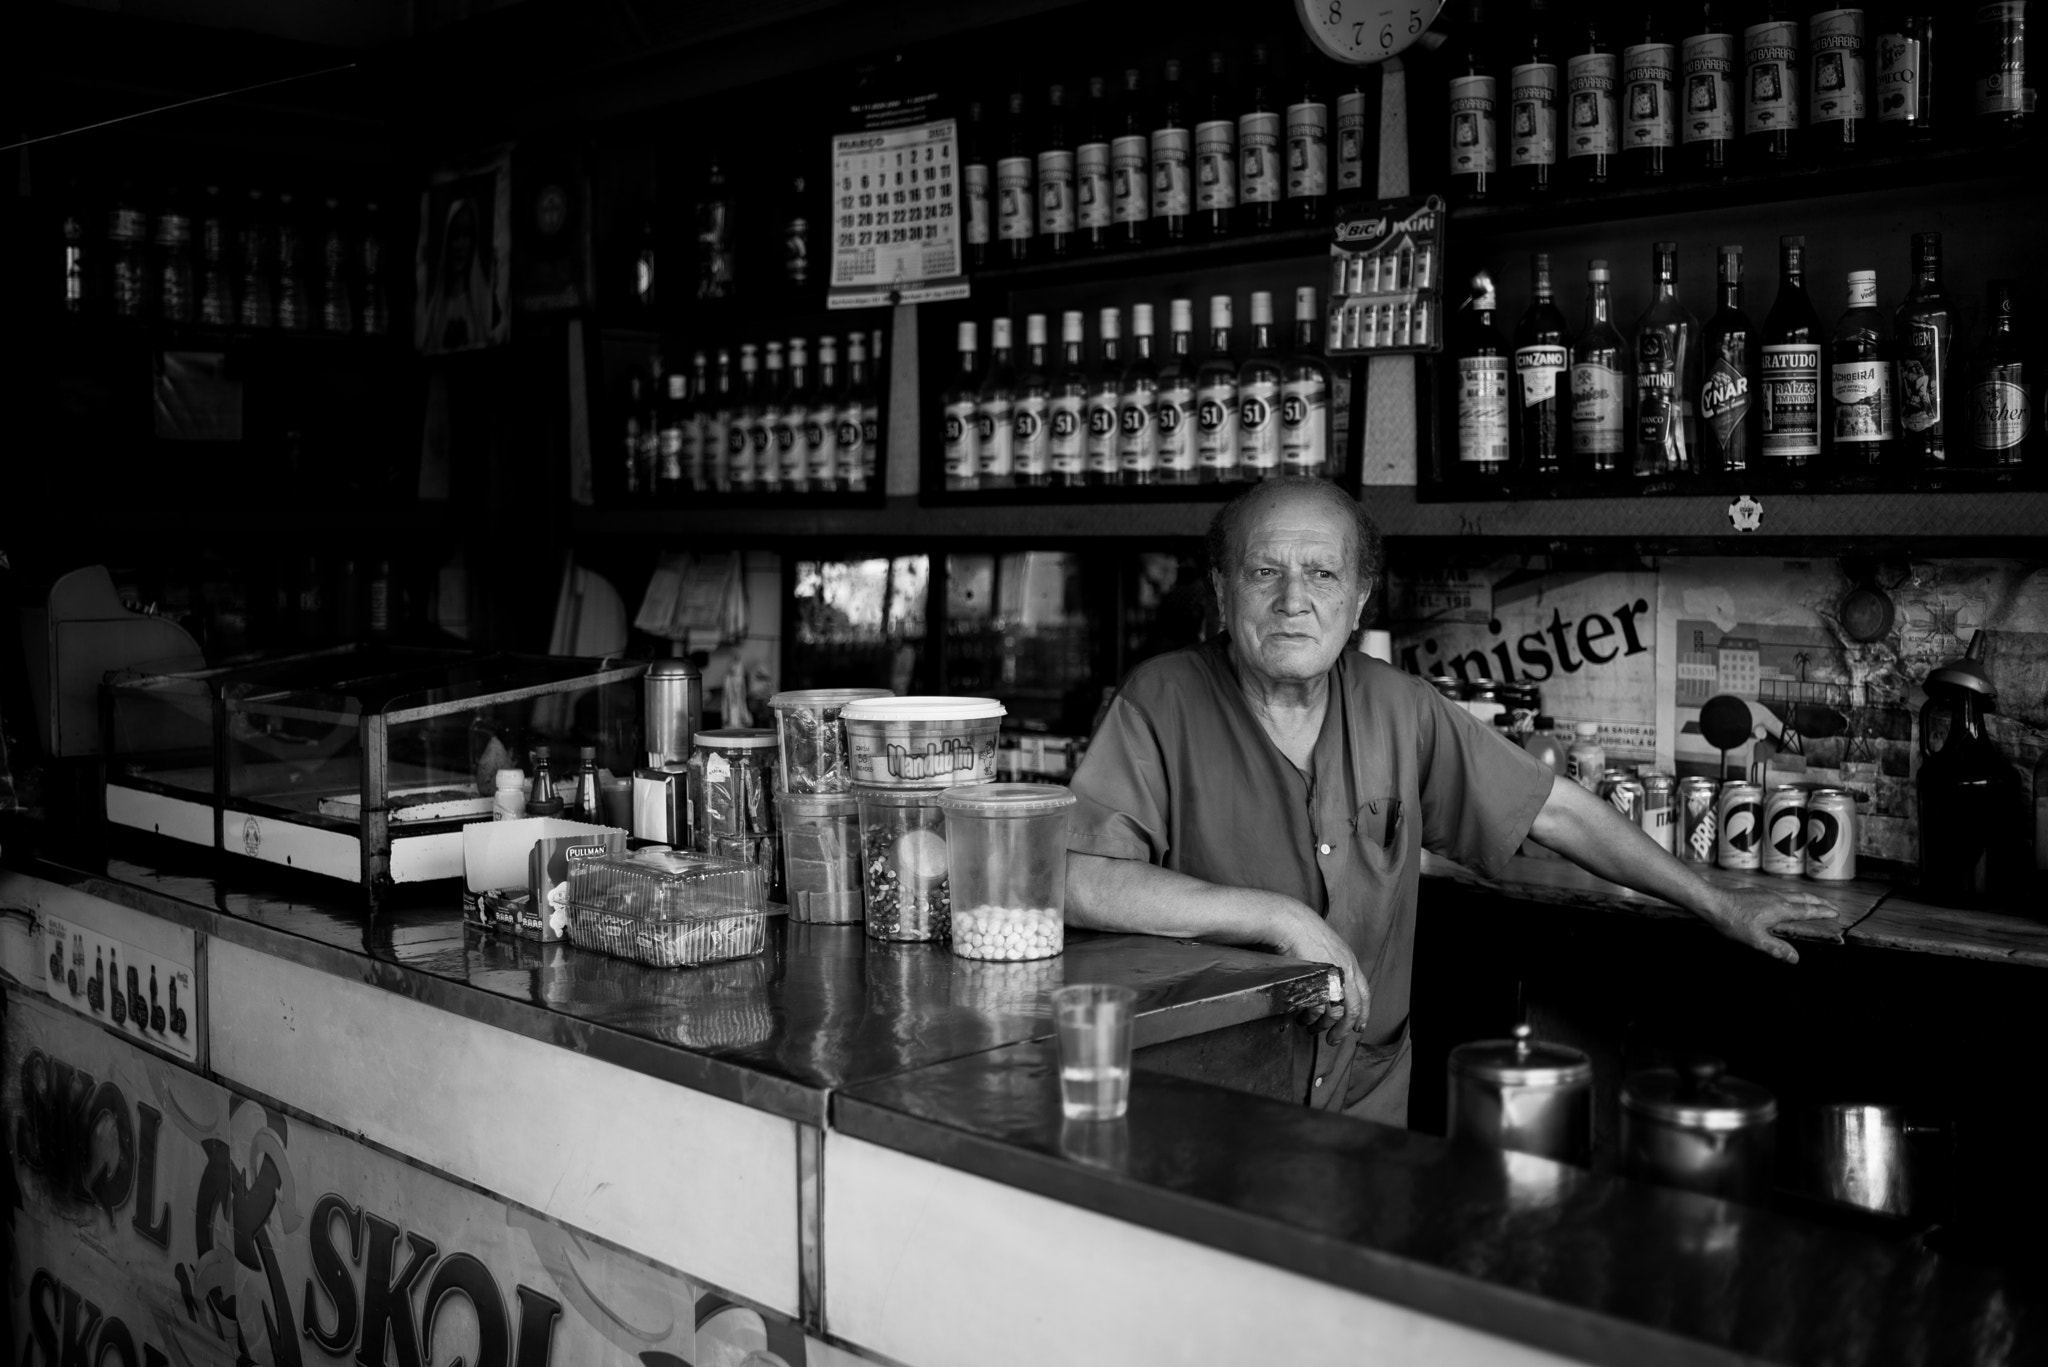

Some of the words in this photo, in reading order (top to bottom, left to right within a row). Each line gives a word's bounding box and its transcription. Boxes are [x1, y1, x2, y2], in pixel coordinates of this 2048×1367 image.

[1408, 9, 1422, 34] 5
[1352, 21, 1365, 46] 7
[1379, 23, 1394, 49] 6
[896, 153, 902, 167] 1
[911, 150, 918, 164] 2
[926, 147, 934, 162] 3
[942, 145, 949, 158] 4
[843, 177, 852, 191] 5
[861, 175, 869, 189] 6
[880, 173, 886, 187] 7
[896, 171, 903, 186] 8
[911, 169, 918, 183] 9
[924, 166, 936, 181] 10
[941, 164, 951, 178] 11
[842, 195, 854, 210] 12
[859, 193, 872, 208] 13
[877, 192, 889, 207] 14
[893, 190, 906, 204] 15
[910, 188, 921, 202] 16
[926, 186, 936, 200] 17
[941, 183, 952, 198] 18
[841, 213, 855, 228] 19
[859, 212, 873, 227] 20
[877, 211, 889, 225] 21
[893, 209, 906, 224] 22
[910, 207, 922, 221] 23
[925, 205, 937, 220] 24
[940, 202, 953, 217] 25
[840, 232, 855, 247] 26
[859, 231, 872, 245] 27
[876, 230, 890, 244] 28
[893, 228, 907, 243] 29
[910, 226, 923, 241] 30
[925, 225, 937, 239] 31
[1517, 353, 1563, 367] CINZANO
[1701, 376, 1748, 419] CYNAR
[1123, 410, 1140, 430] 51
[1160, 408, 1175, 428] 51
[1201, 405, 1219, 425] 51
[1243, 403, 1262, 423] 51
[1284, 401, 1300, 421] 51
[1976, 401, 2027, 421] Dreher
[1016, 416, 1032, 434] 51
[1054, 414, 1073, 433] 51
[1092, 412, 1110, 431] 51
[569, 845, 606, 858] PULLMAN
[17, 1047, 171, 1250] SKOL
